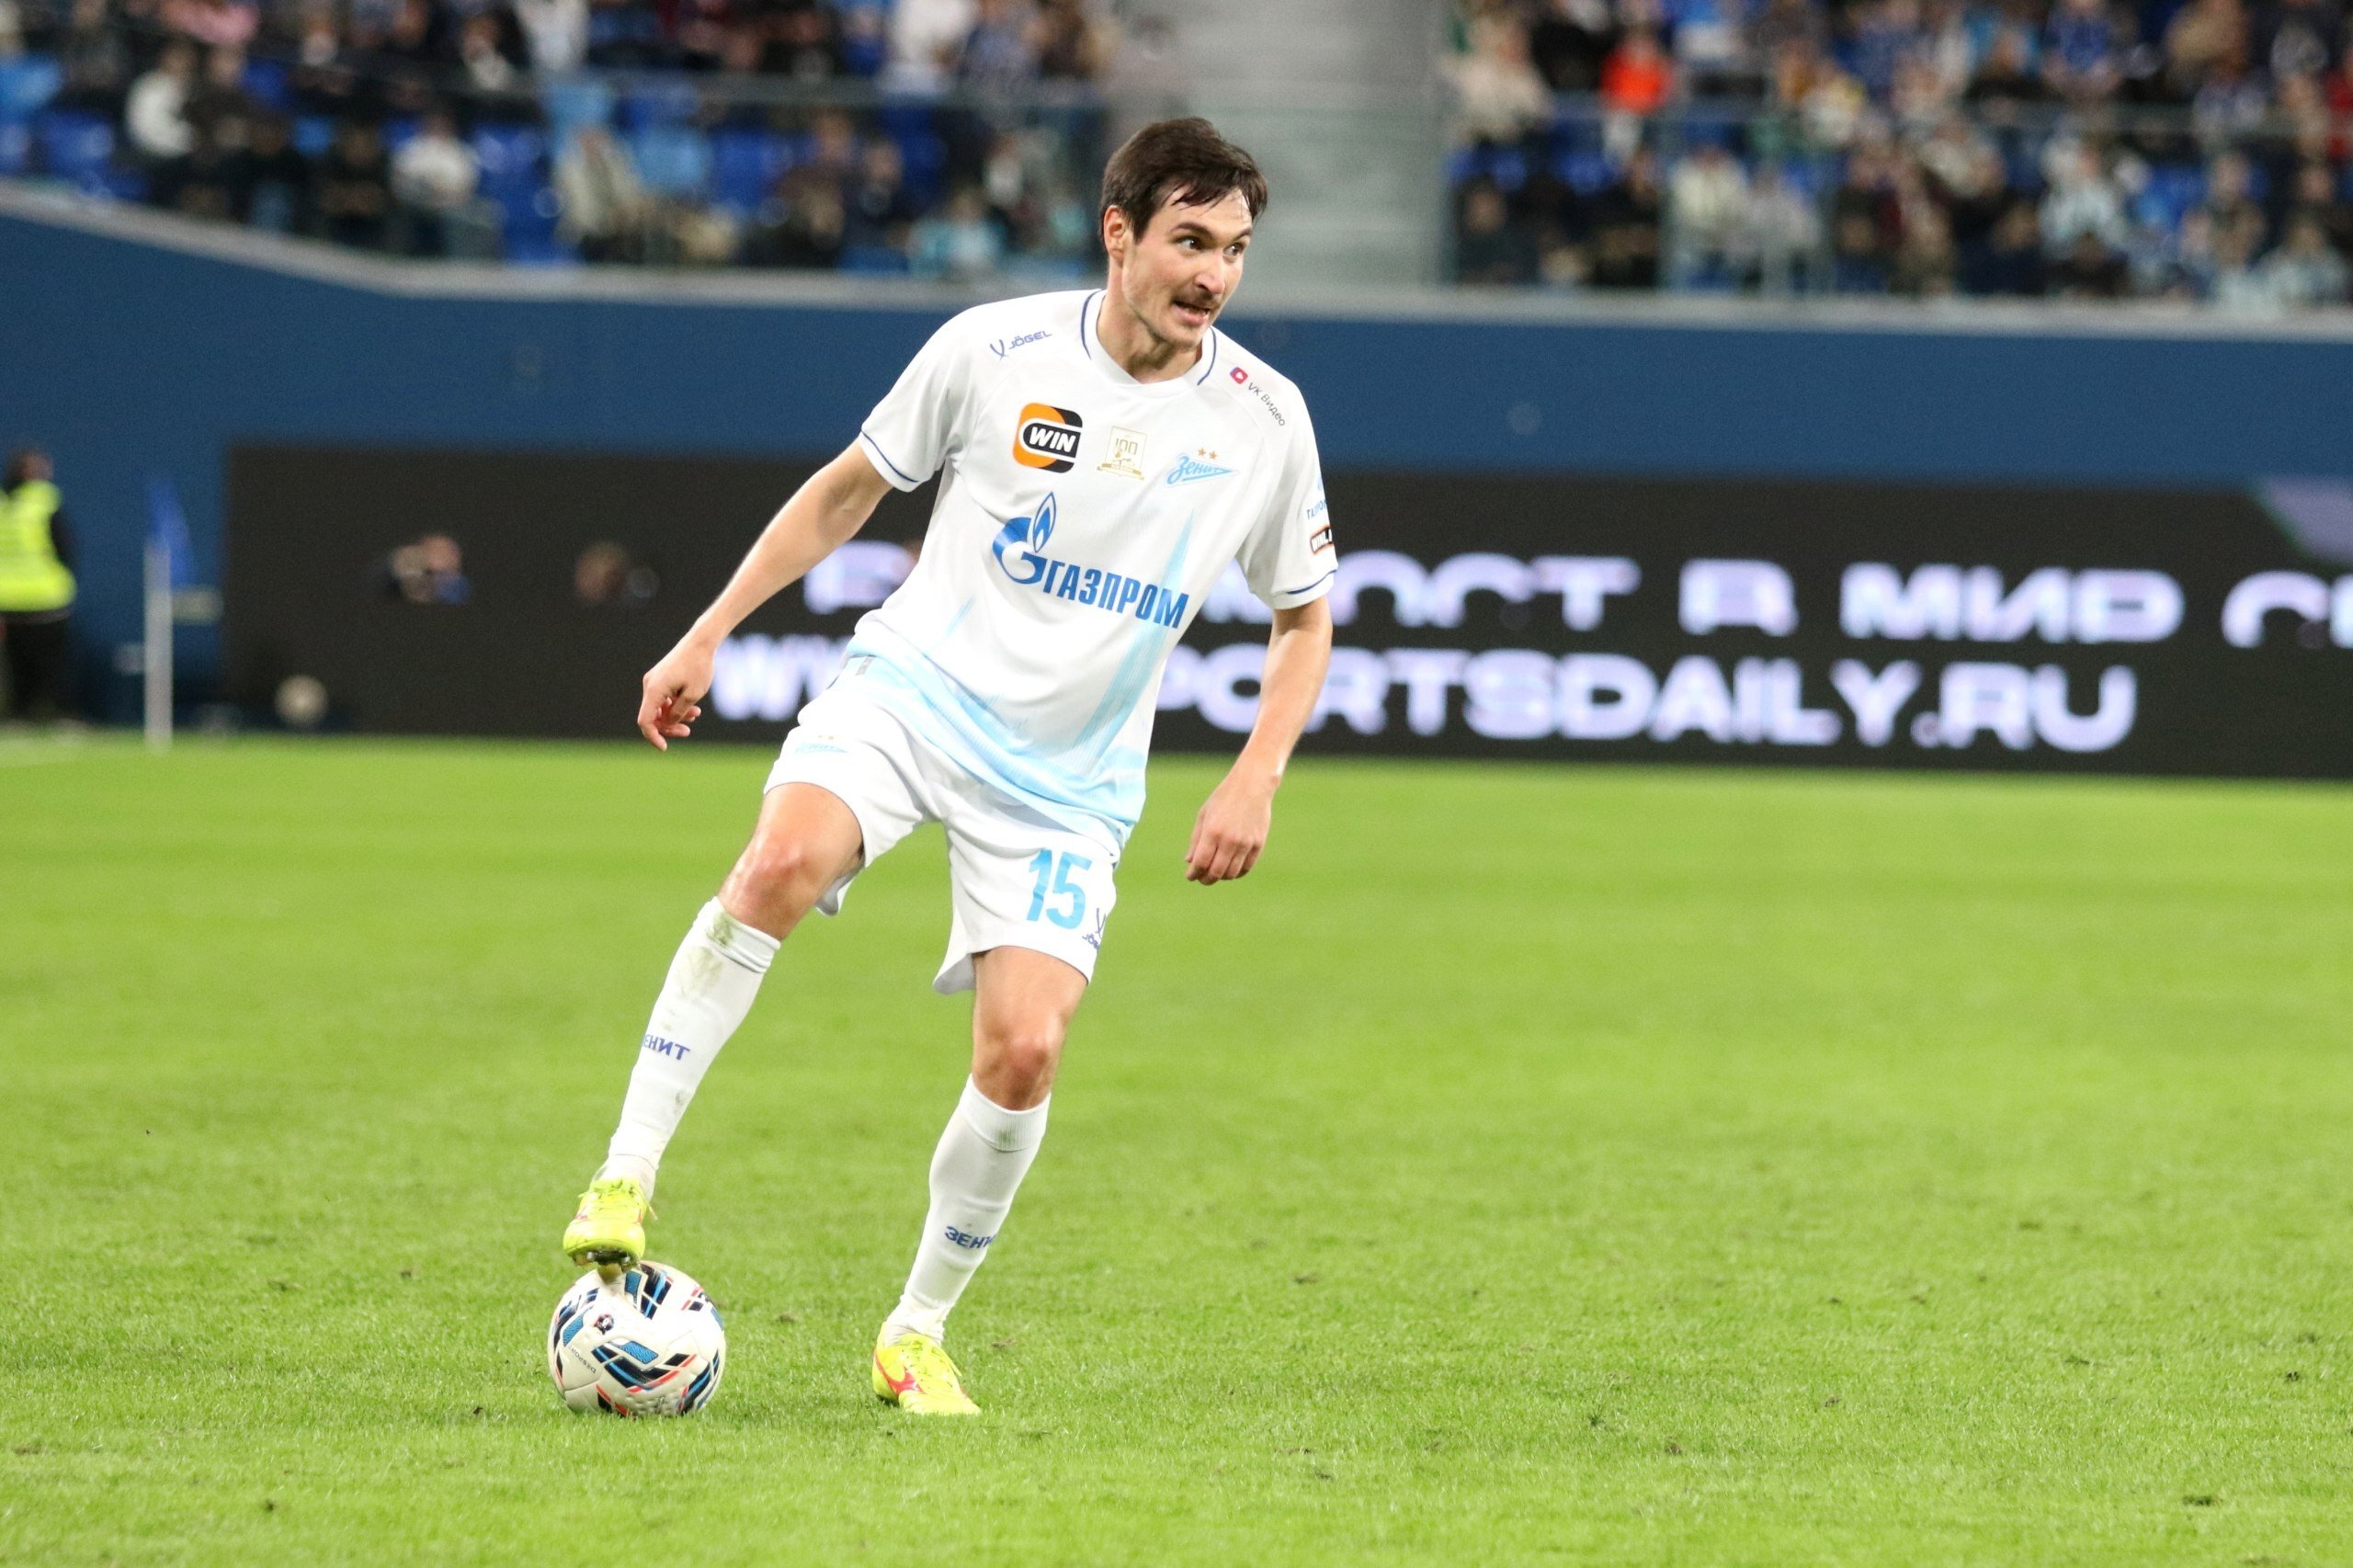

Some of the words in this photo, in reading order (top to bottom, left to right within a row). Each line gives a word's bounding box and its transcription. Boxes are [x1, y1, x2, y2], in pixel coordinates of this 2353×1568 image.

[1008, 330, 1052, 349] JÖGEL
[1248, 382, 1264, 396] VK
[1260, 393, 1286, 426] Видео
[1029, 426, 1077, 453] WIN
[1042, 559, 1190, 630] ГАЗПРОМ
[1026, 847, 1093, 930] 15
